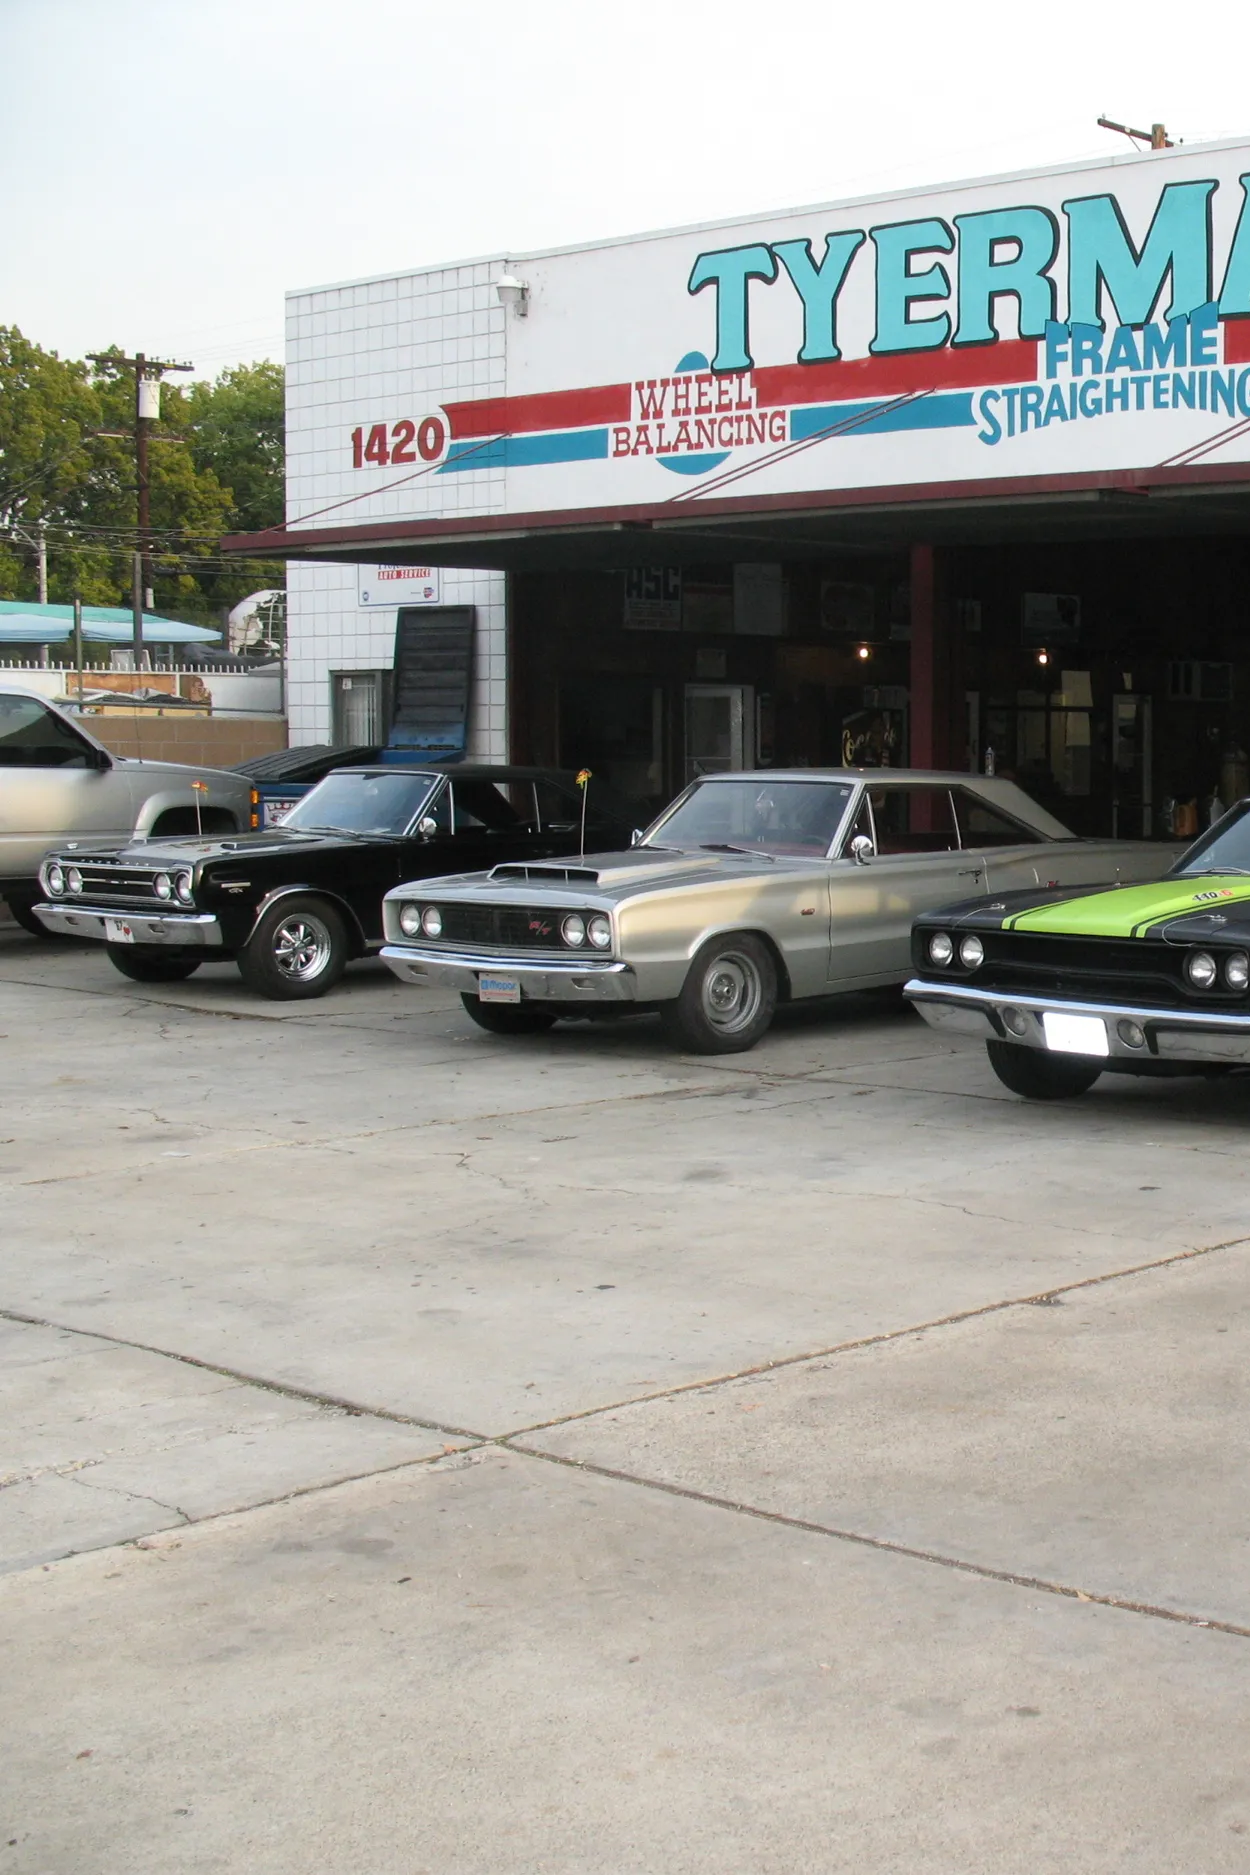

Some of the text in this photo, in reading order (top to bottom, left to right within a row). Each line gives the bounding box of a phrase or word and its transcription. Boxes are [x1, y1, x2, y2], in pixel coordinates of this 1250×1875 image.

[1045, 301, 1219, 380] FRAME
[635, 372, 753, 421] WHEEL
[351, 416, 445, 469] 1420
[612, 410, 786, 458] BALANCING
[379, 568, 430, 579] AUTO SERVICE
